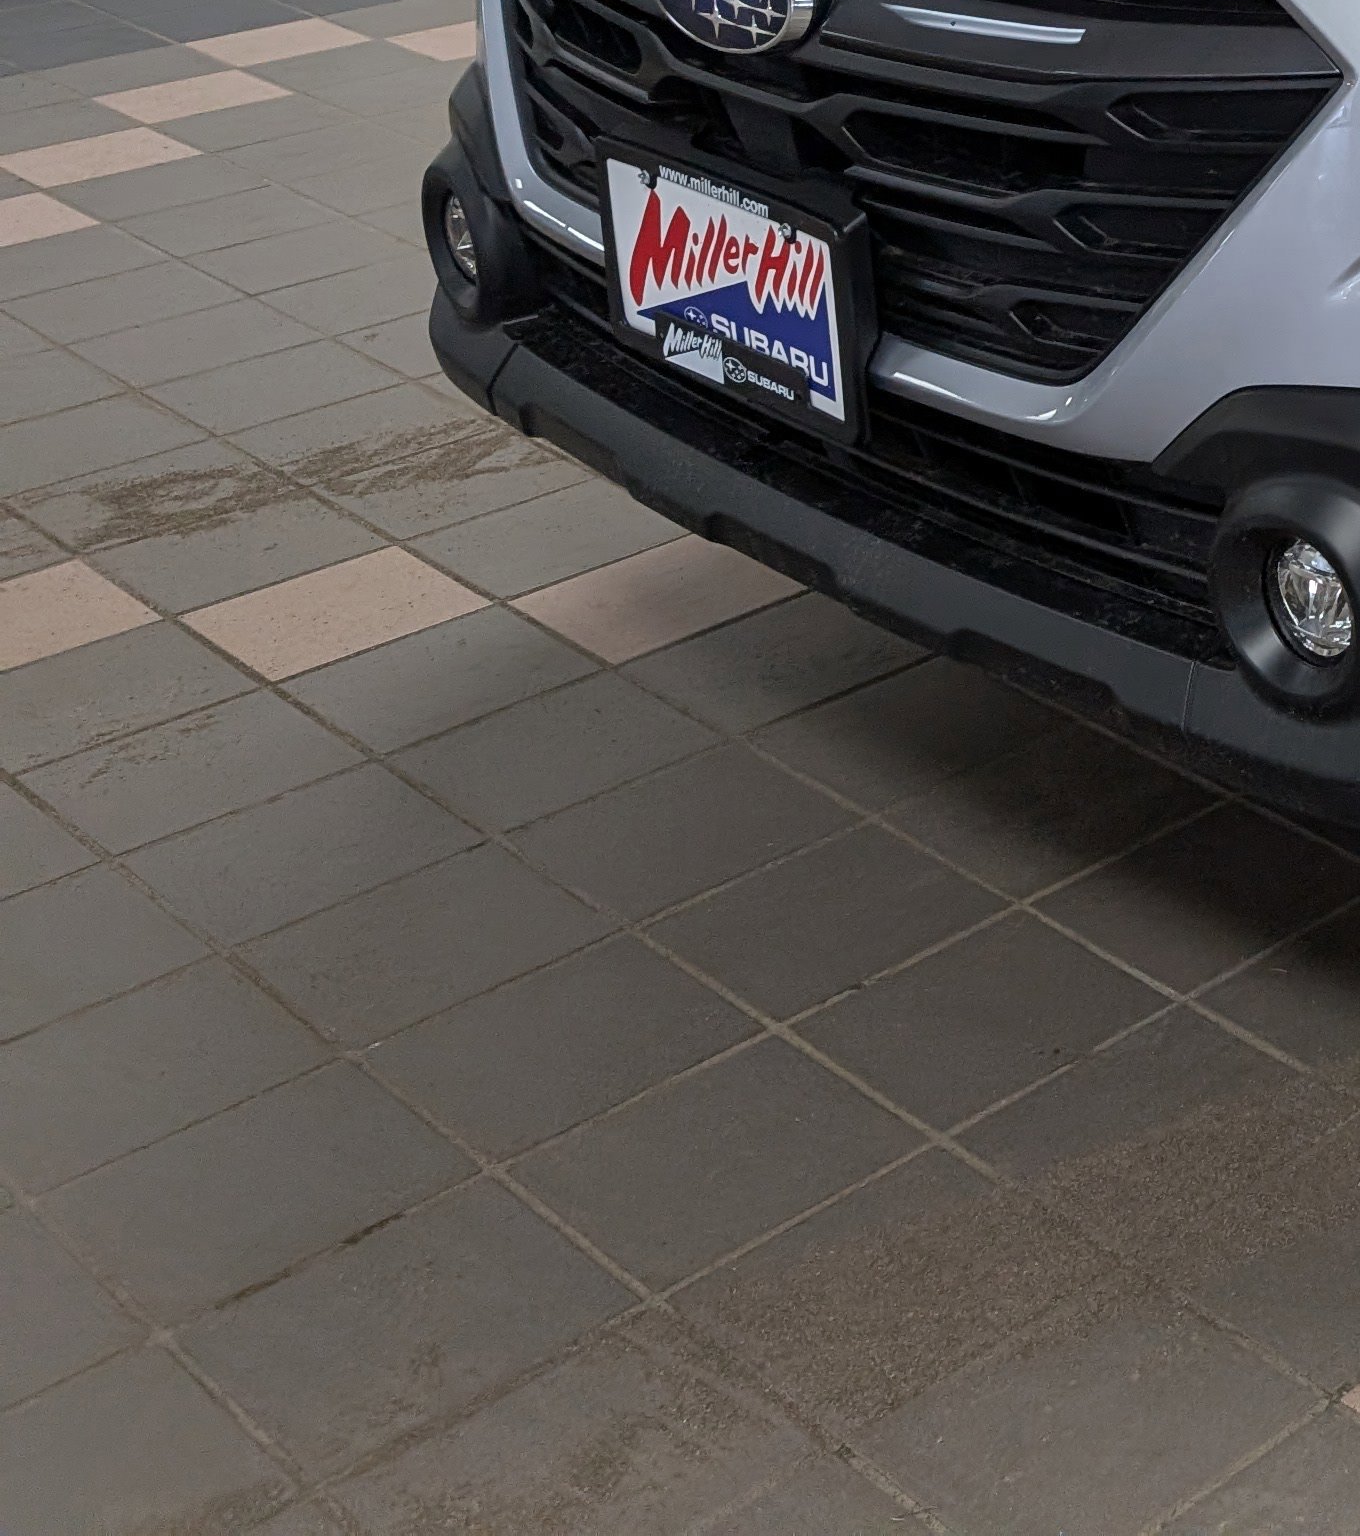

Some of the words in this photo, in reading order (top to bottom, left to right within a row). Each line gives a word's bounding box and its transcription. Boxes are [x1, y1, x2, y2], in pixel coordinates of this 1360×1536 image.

[658, 165, 769, 218] www.millerhill.com
[711, 313, 829, 387] SUBARU
[747, 370, 795, 401] SUBARU
